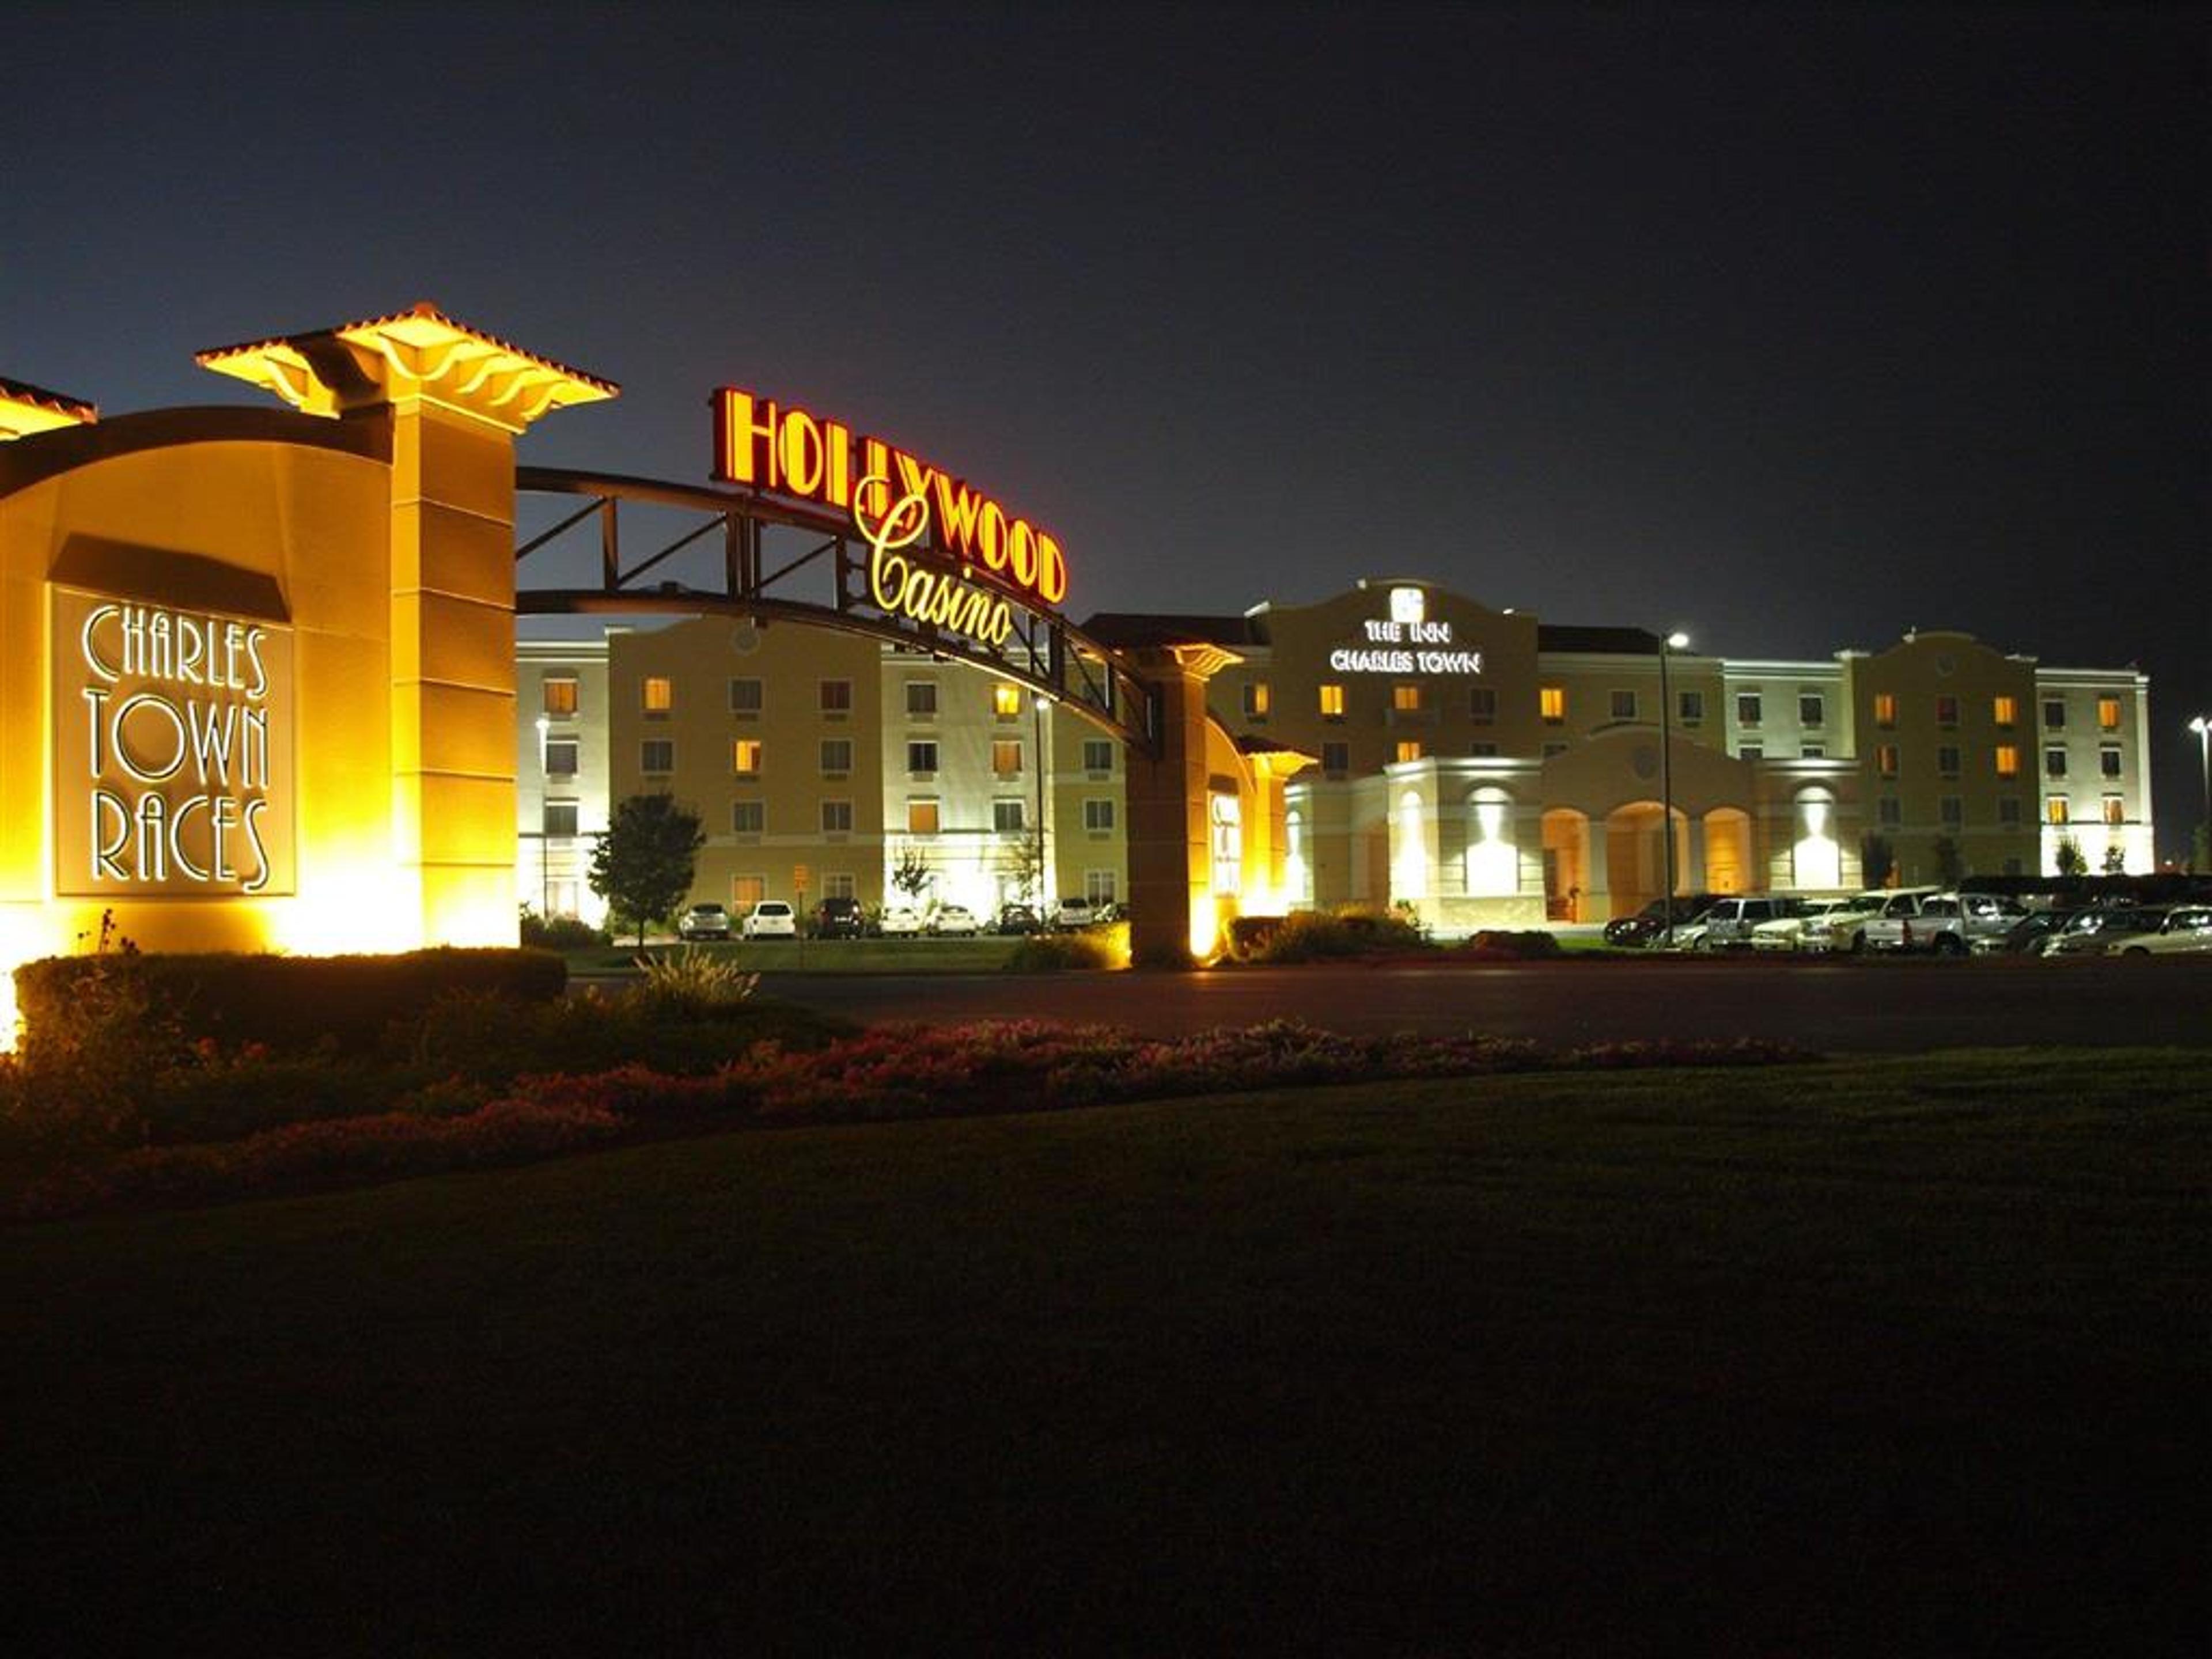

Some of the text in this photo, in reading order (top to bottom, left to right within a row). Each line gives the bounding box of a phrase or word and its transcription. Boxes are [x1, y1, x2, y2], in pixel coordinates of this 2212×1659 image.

[722, 388, 1067, 605] HOLLYWOOD
[854, 474, 1012, 646] Casino
[82, 604, 267, 699] CHARLES
[1330, 649, 1481, 674] CHARLES TOWN
[1365, 620, 1449, 643] THE INN
[82, 687, 269, 789] TOWN
[92, 790, 270, 894] RACES
